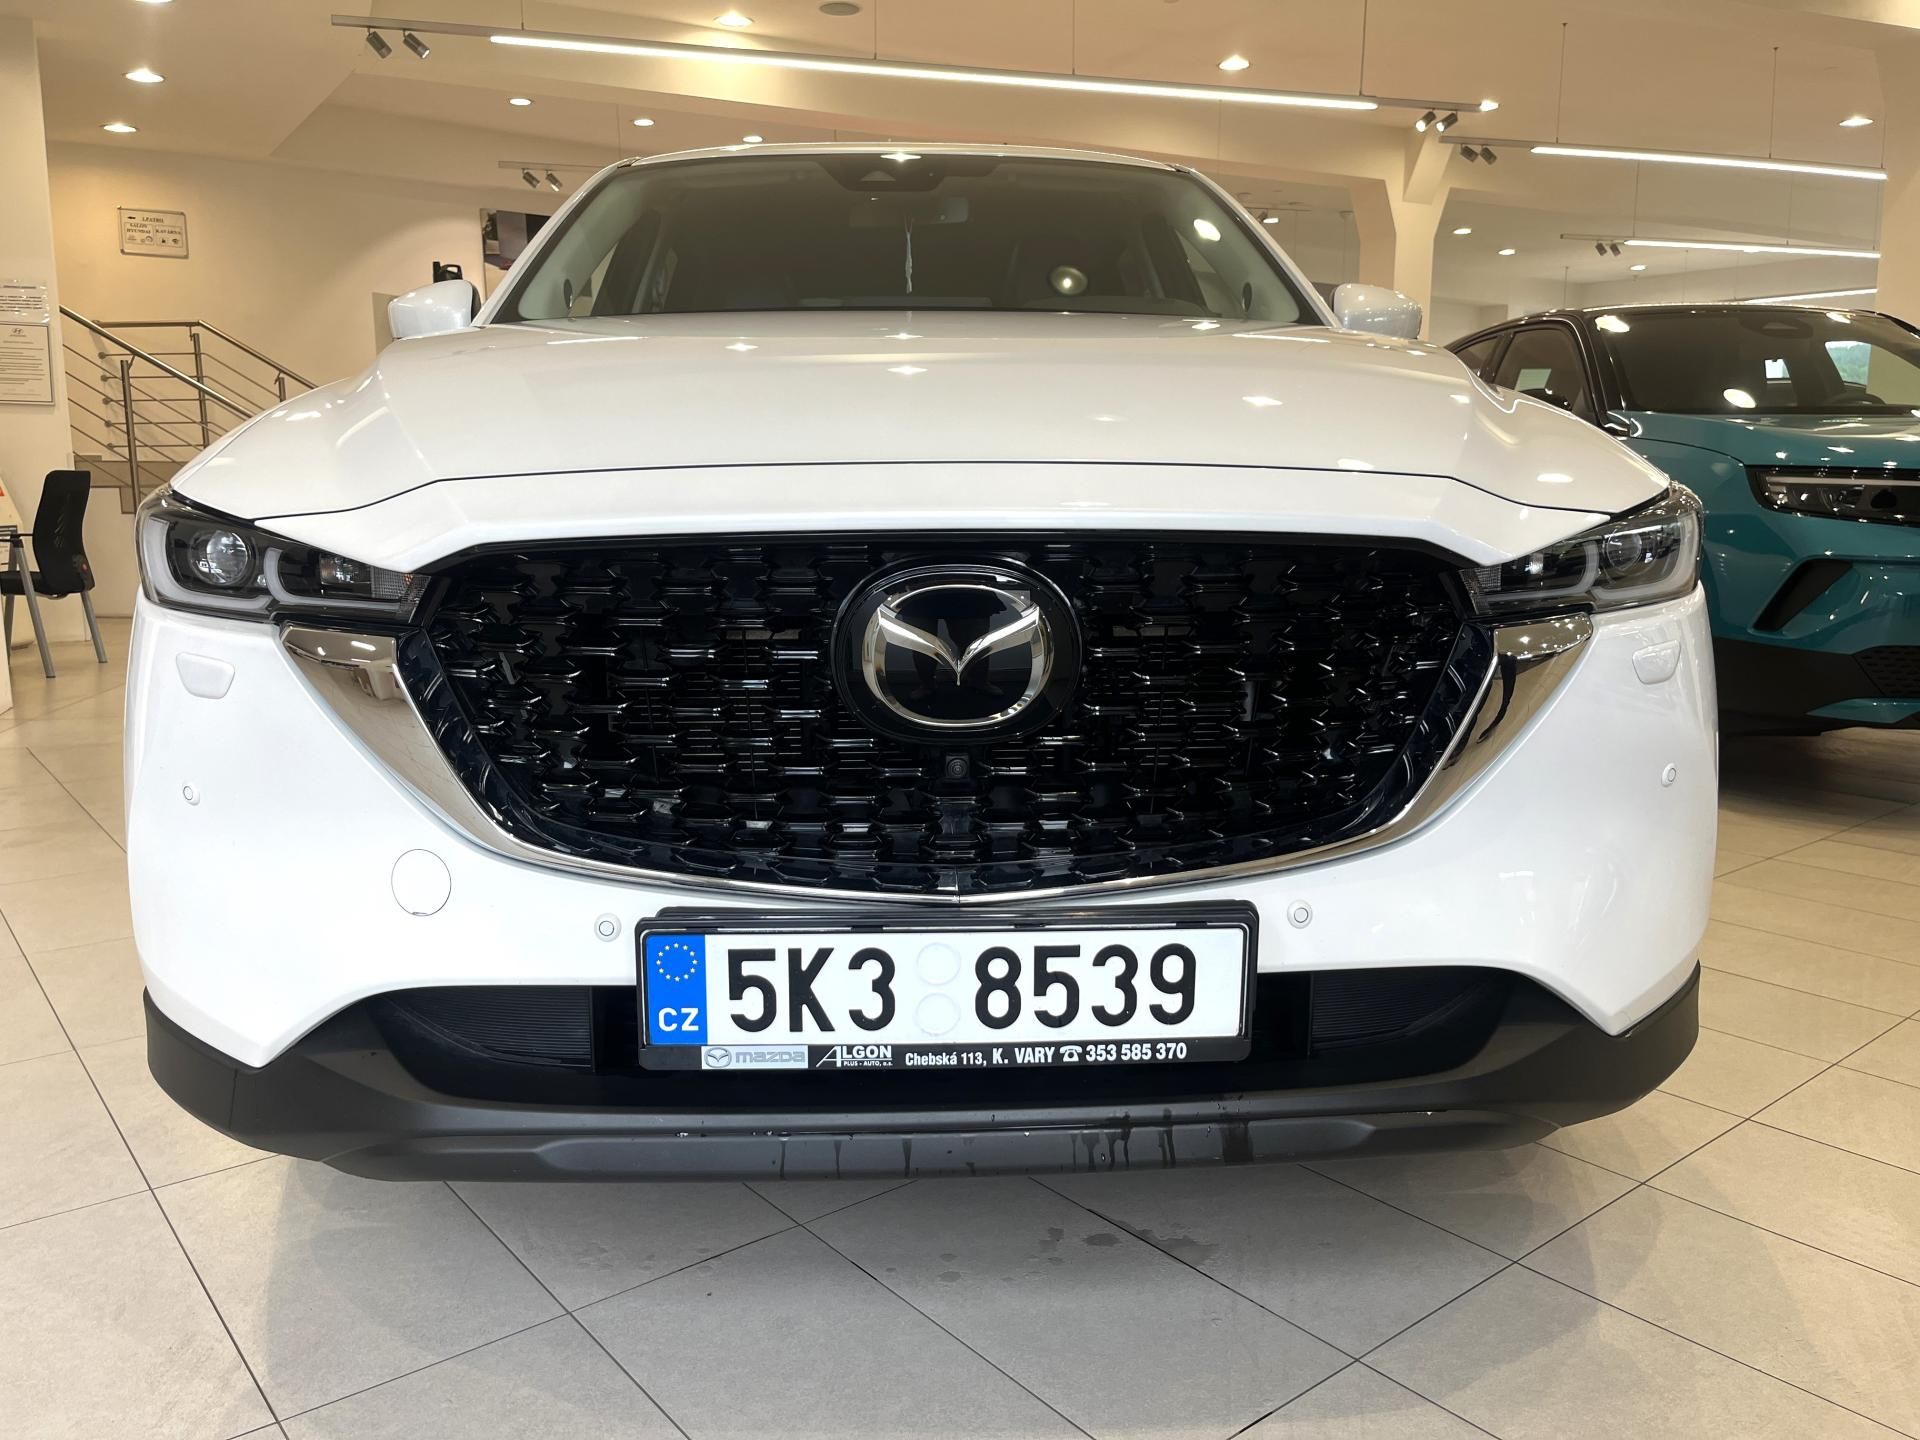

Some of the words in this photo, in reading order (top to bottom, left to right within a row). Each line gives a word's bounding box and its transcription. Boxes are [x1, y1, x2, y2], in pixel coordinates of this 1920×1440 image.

[728, 947, 896, 1032] 5K3
[975, 943, 1197, 1029] 8539
[658, 1007, 699, 1032] CZ
[816, 1045, 892, 1067] ALGON
[905, 1051, 958, 1066] Chebská
[961, 1052, 987, 1067] 113,
[992, 1048, 1009, 1064] K.
[1015, 1047, 1055, 1064] VARY
[1085, 1045, 1117, 1062] 353
[1120, 1043, 1151, 1061] 585
[1156, 1042, 1187, 1060] 370
